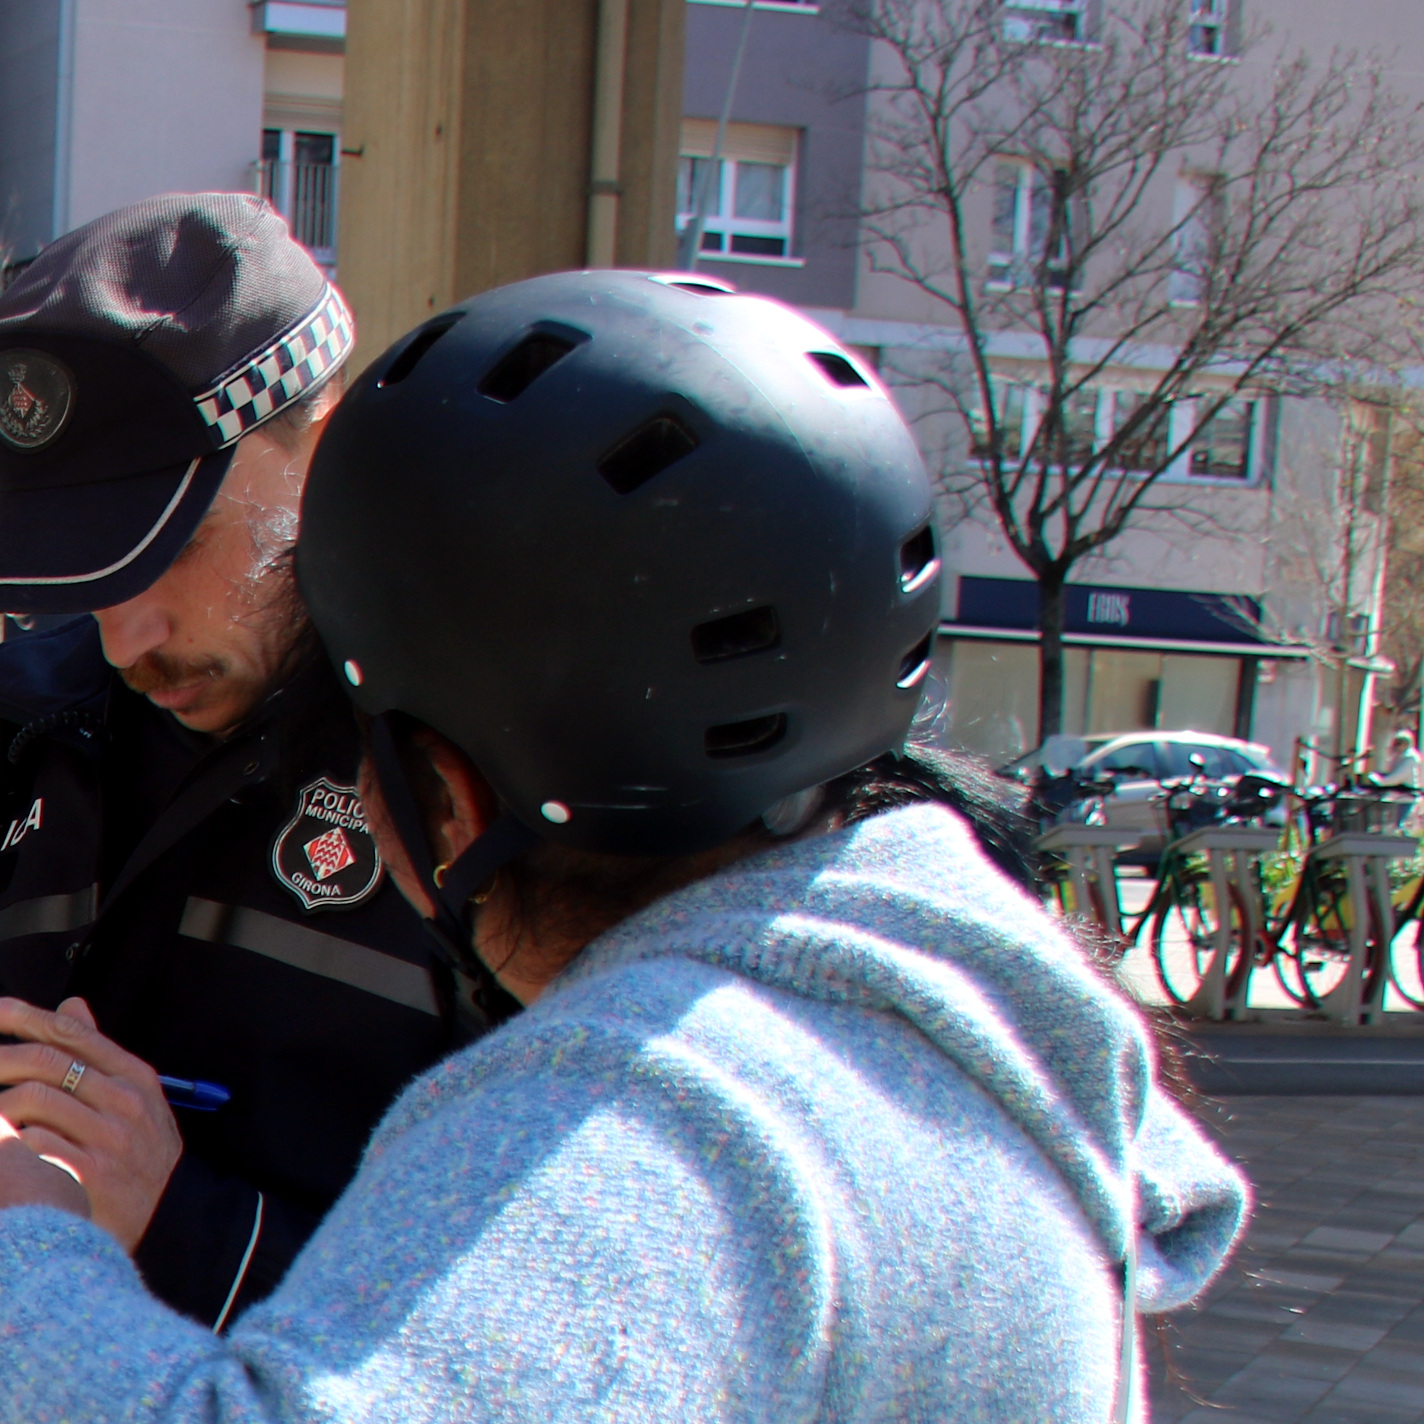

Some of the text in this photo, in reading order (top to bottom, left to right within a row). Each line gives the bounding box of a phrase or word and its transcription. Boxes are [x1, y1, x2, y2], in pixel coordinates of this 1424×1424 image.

[310, 788, 365, 819] POLIC
[305, 804, 369, 835] MUNICIPA
[291, 871, 341, 897] GIRONA
